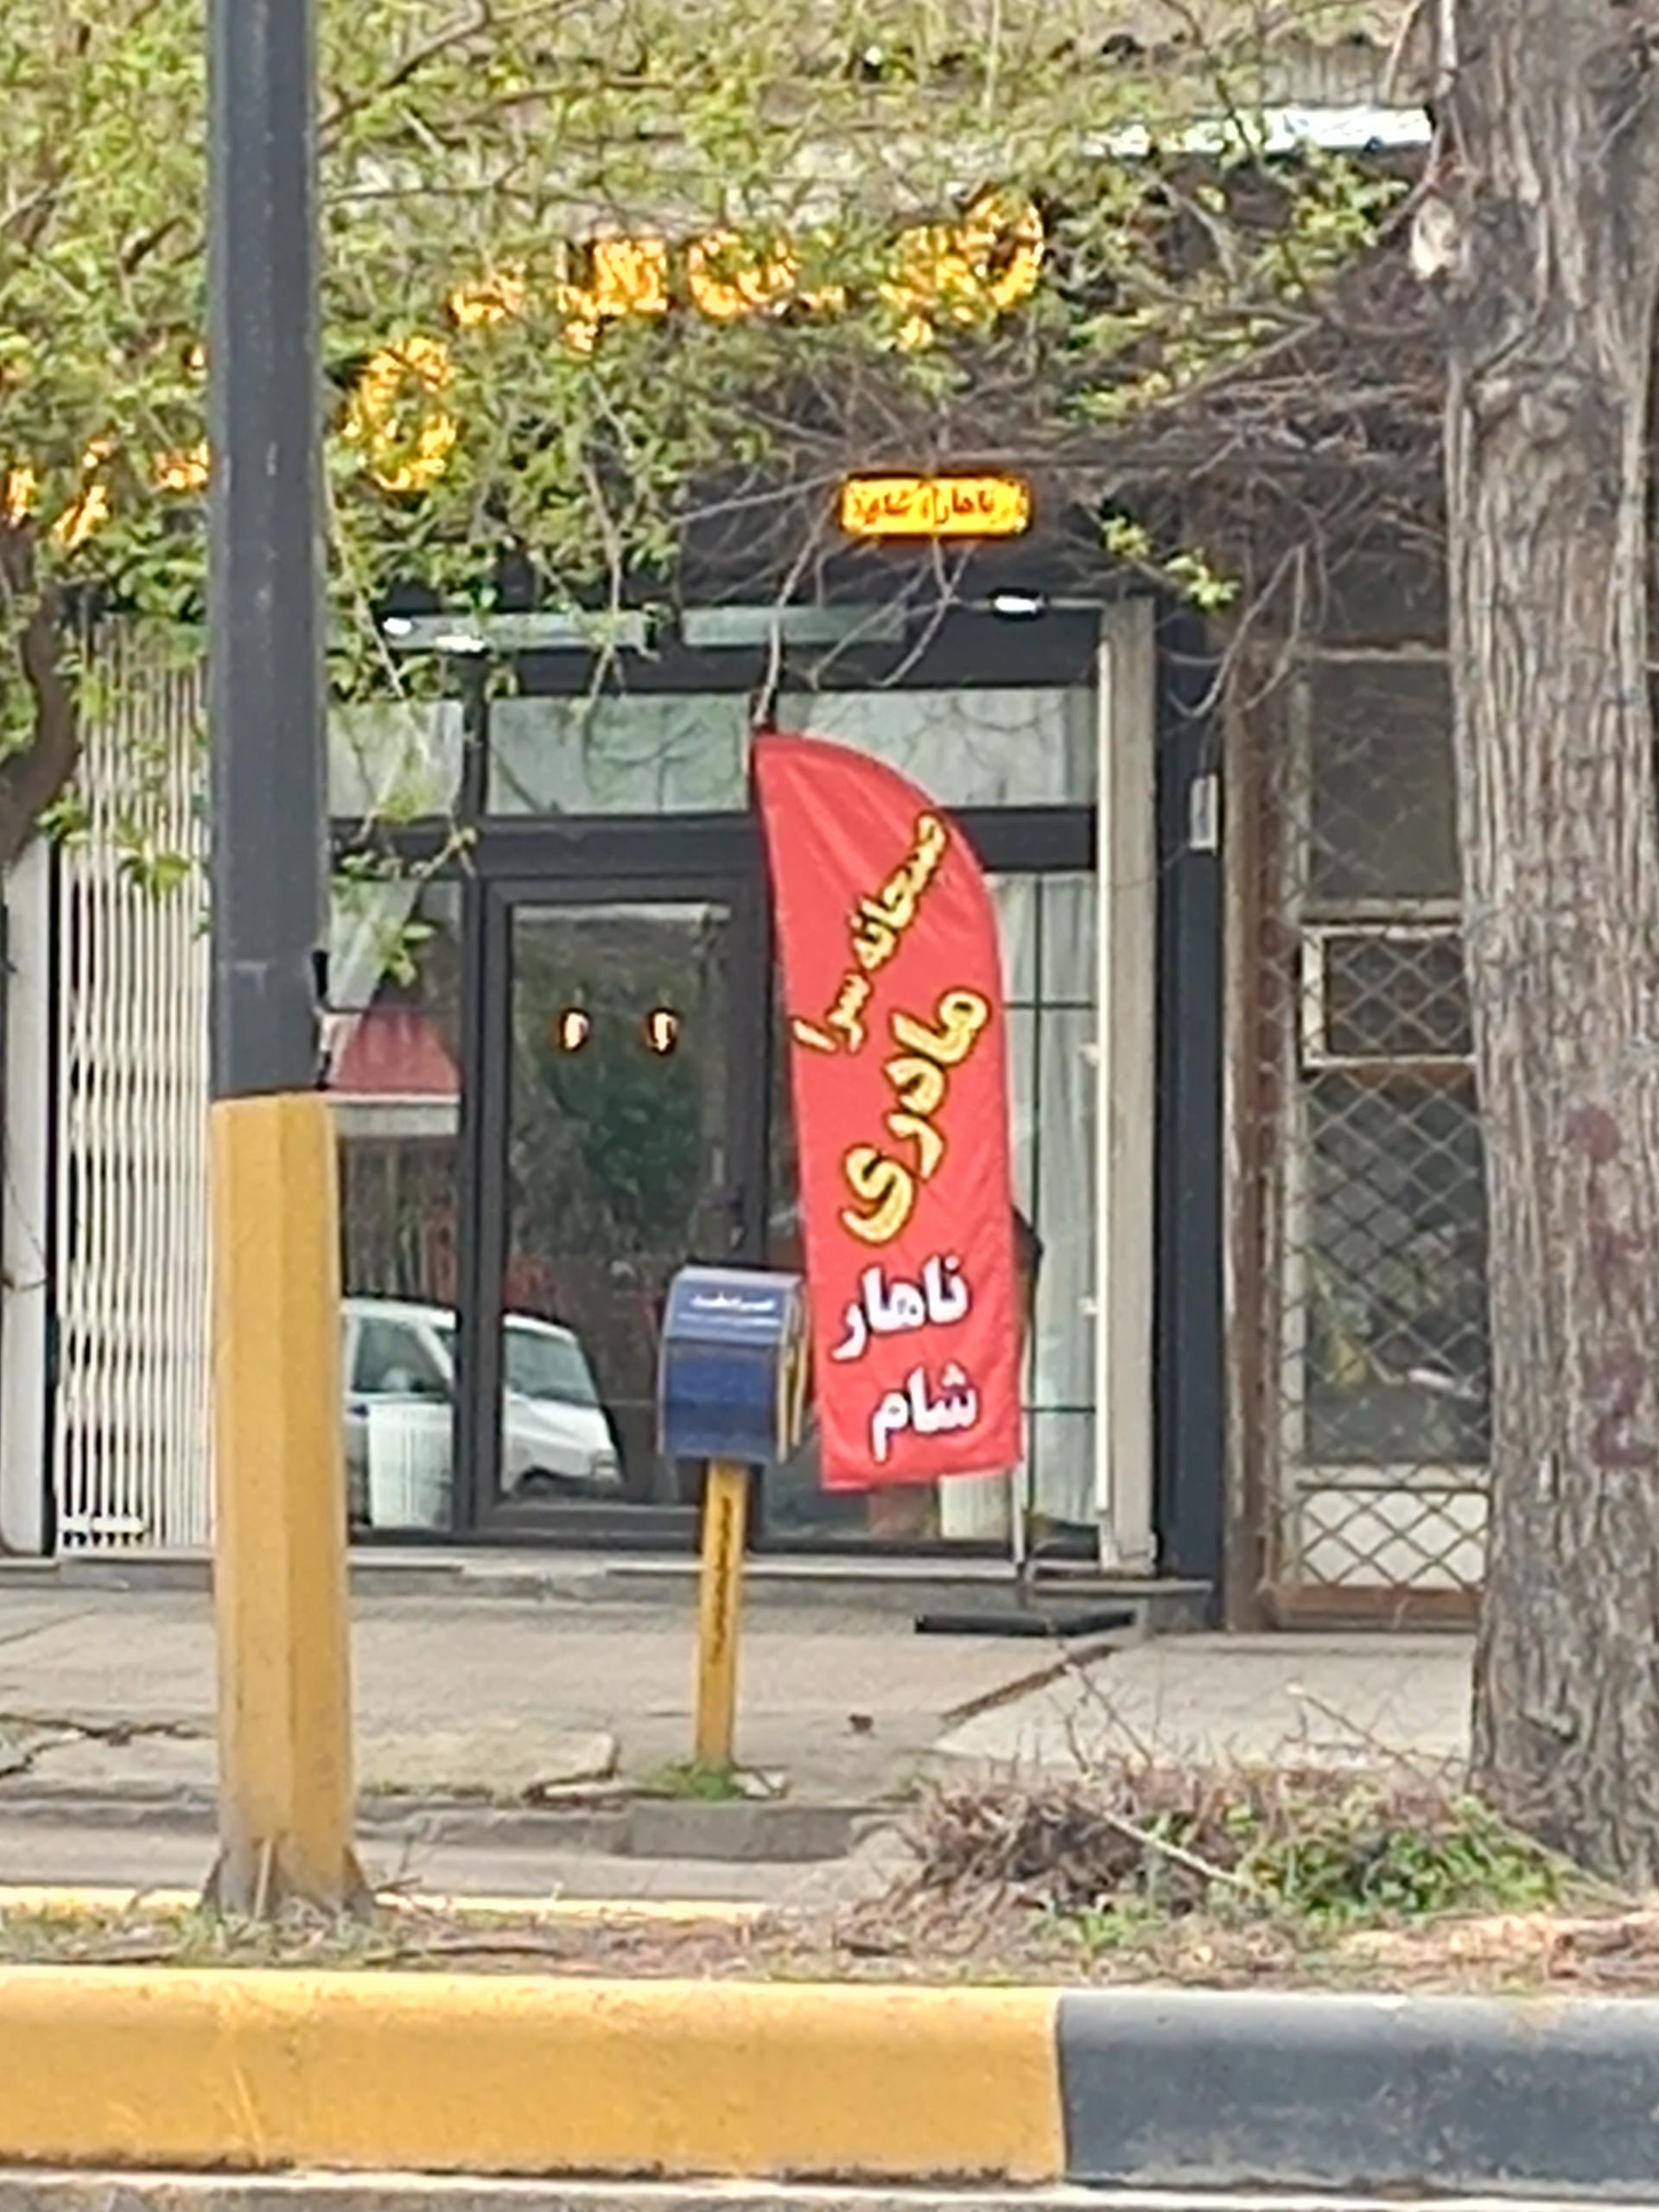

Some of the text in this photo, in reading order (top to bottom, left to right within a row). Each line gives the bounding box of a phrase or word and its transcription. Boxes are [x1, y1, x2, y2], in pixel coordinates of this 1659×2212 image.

[791, 969, 873, 1053] سرا
[838, 988, 992, 1246] مادری
[831, 1253, 970, 1363] ناهار
[871, 1362, 978, 1464] شام
